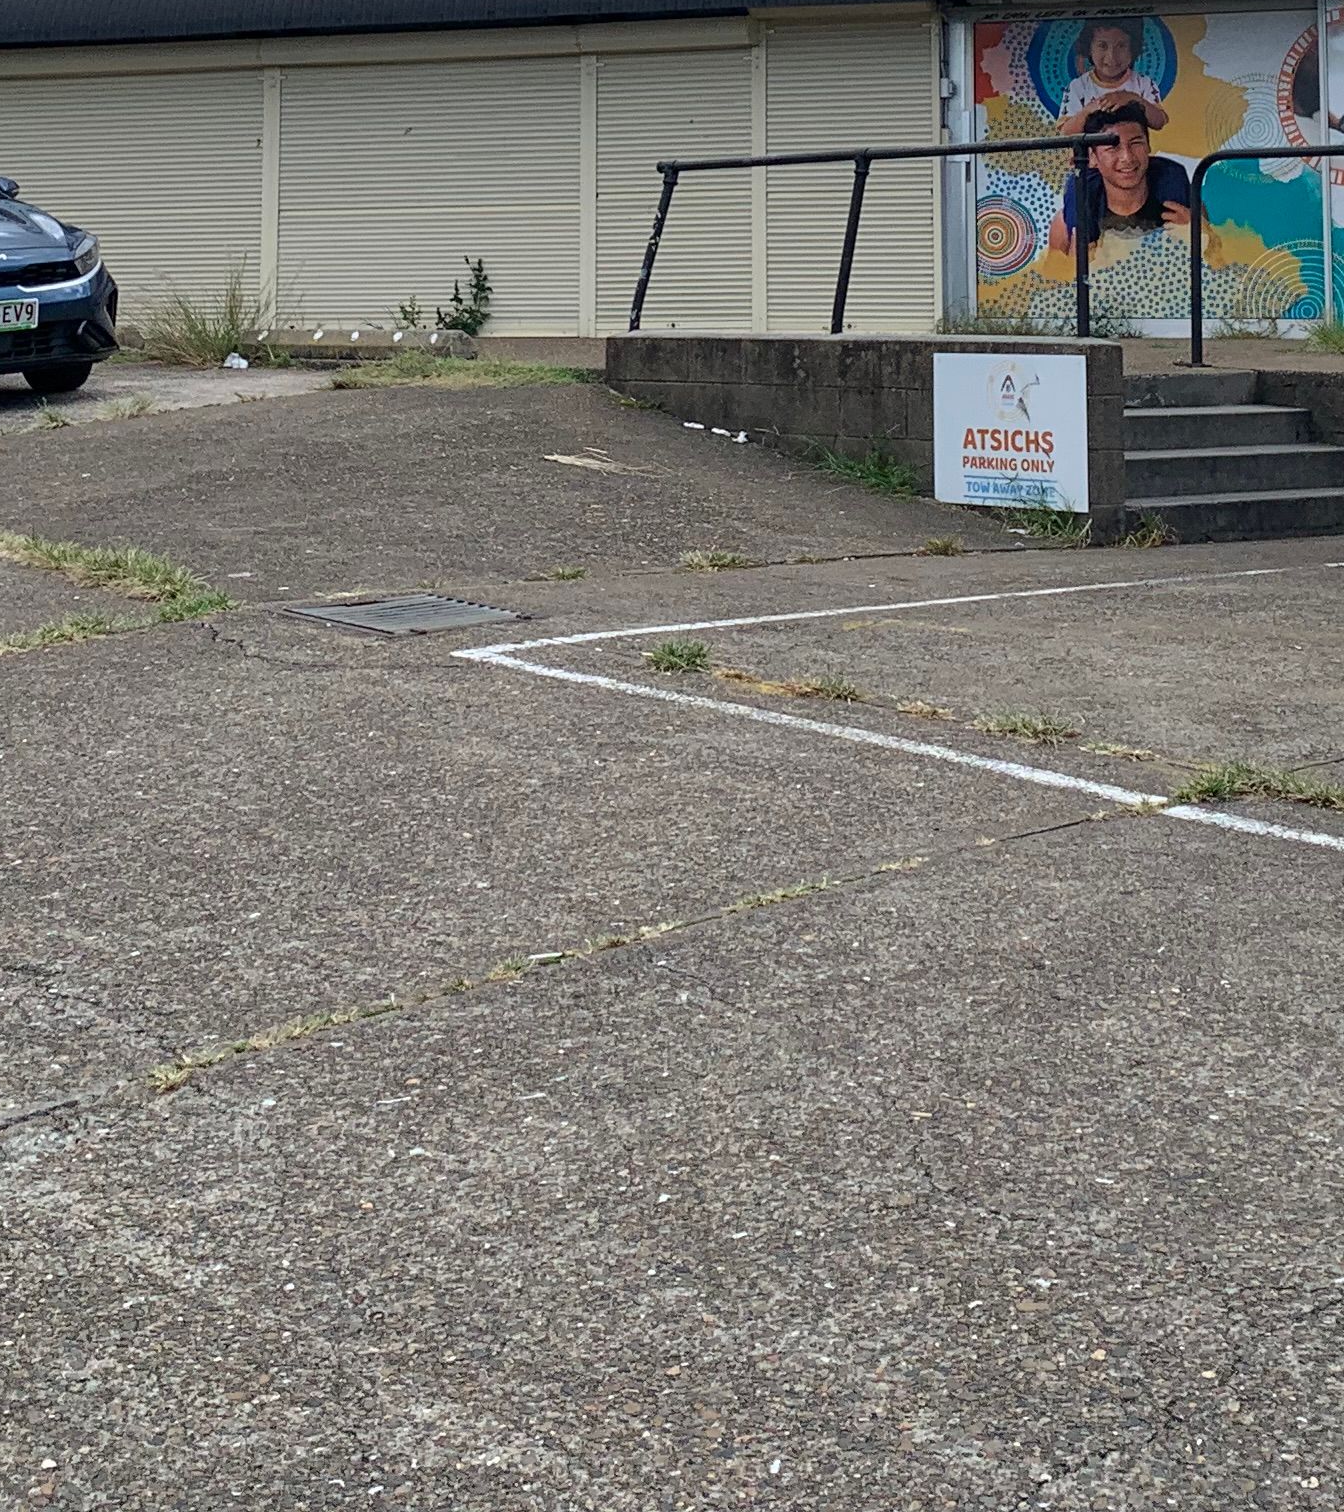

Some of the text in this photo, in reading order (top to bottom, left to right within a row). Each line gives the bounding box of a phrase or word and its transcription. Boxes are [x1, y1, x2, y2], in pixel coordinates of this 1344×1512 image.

[962, 427, 1055, 454] ATSICHS
[962, 455, 1055, 473] PARKING ONLY
[965, 480, 990, 494] TOW
[992, 482, 1025, 496] AWAY
